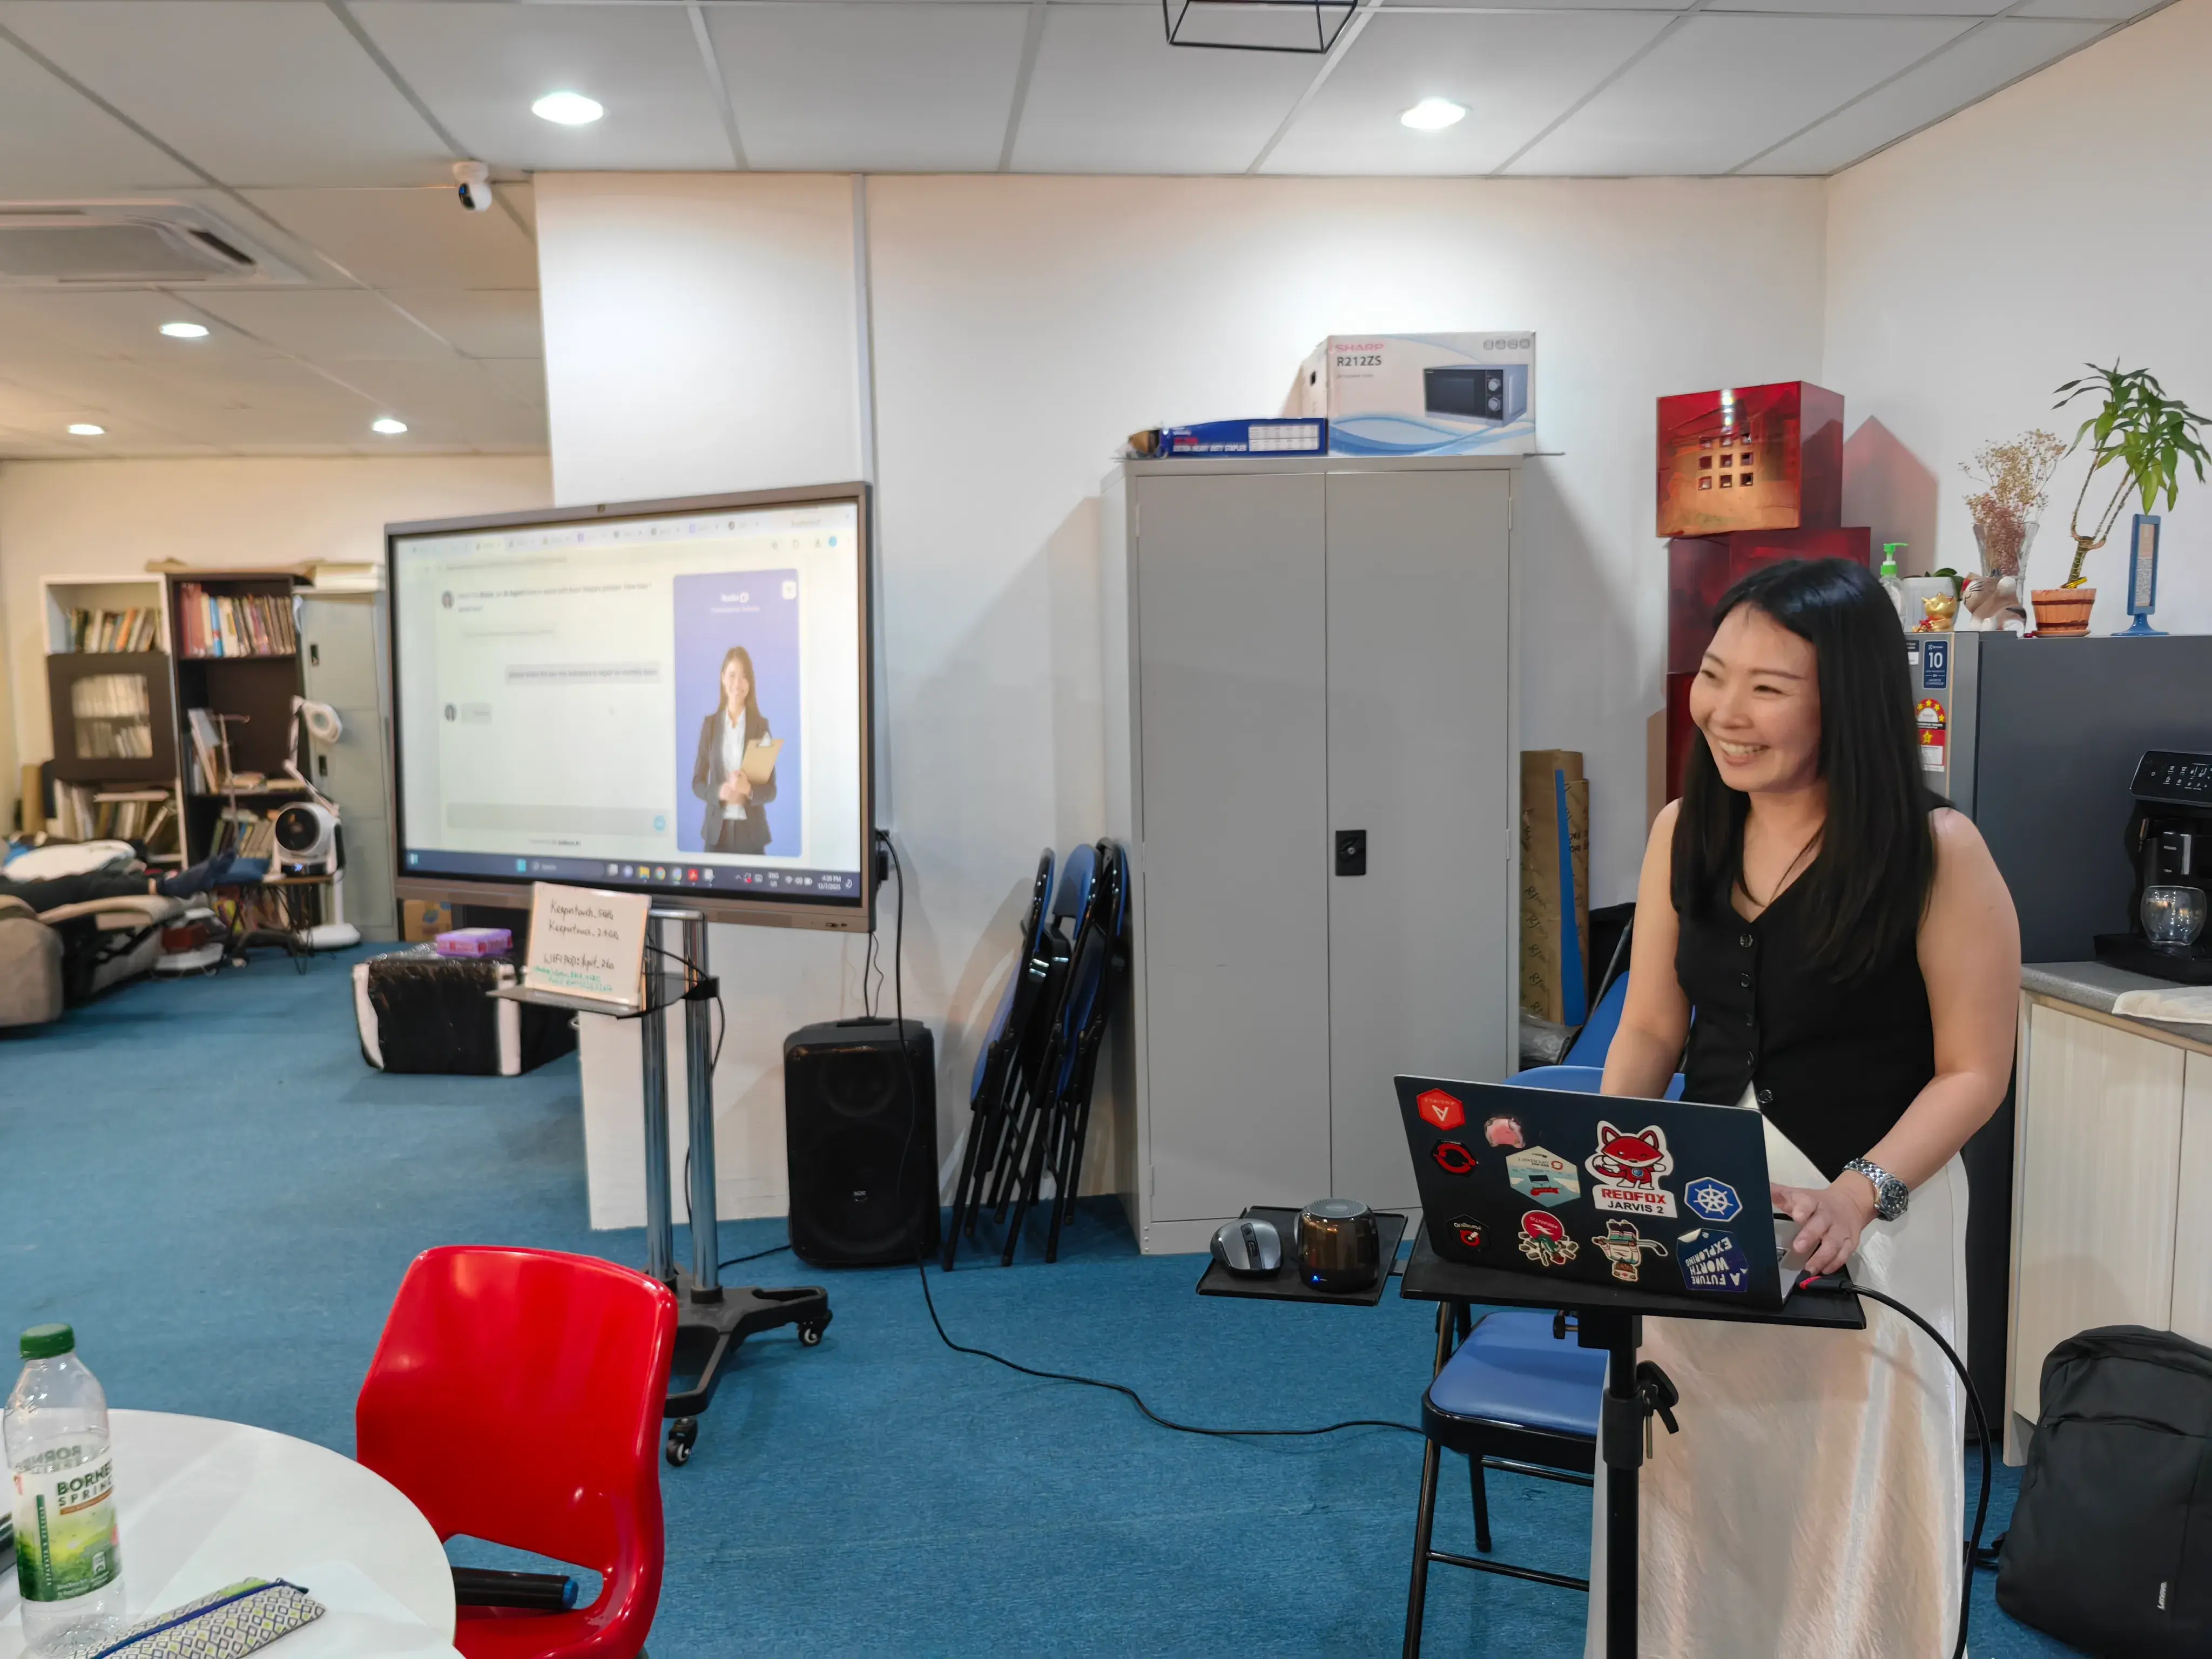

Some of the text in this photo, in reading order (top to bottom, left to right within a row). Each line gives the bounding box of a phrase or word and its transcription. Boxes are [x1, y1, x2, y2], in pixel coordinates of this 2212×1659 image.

[1335, 343, 1384, 352] SHARP
[1337, 355, 1382, 367] R212ZS
[1928, 652, 1943, 668] 10
[1601, 1188, 1667, 1205] REDFOX
[1607, 1201, 1664, 1214] JARVIS 2
[1685, 1237, 1732, 1266] EXPLORING
[1690, 1257, 1729, 1276] WORTH
[1691, 1273, 1740, 1286] A FUTURE
